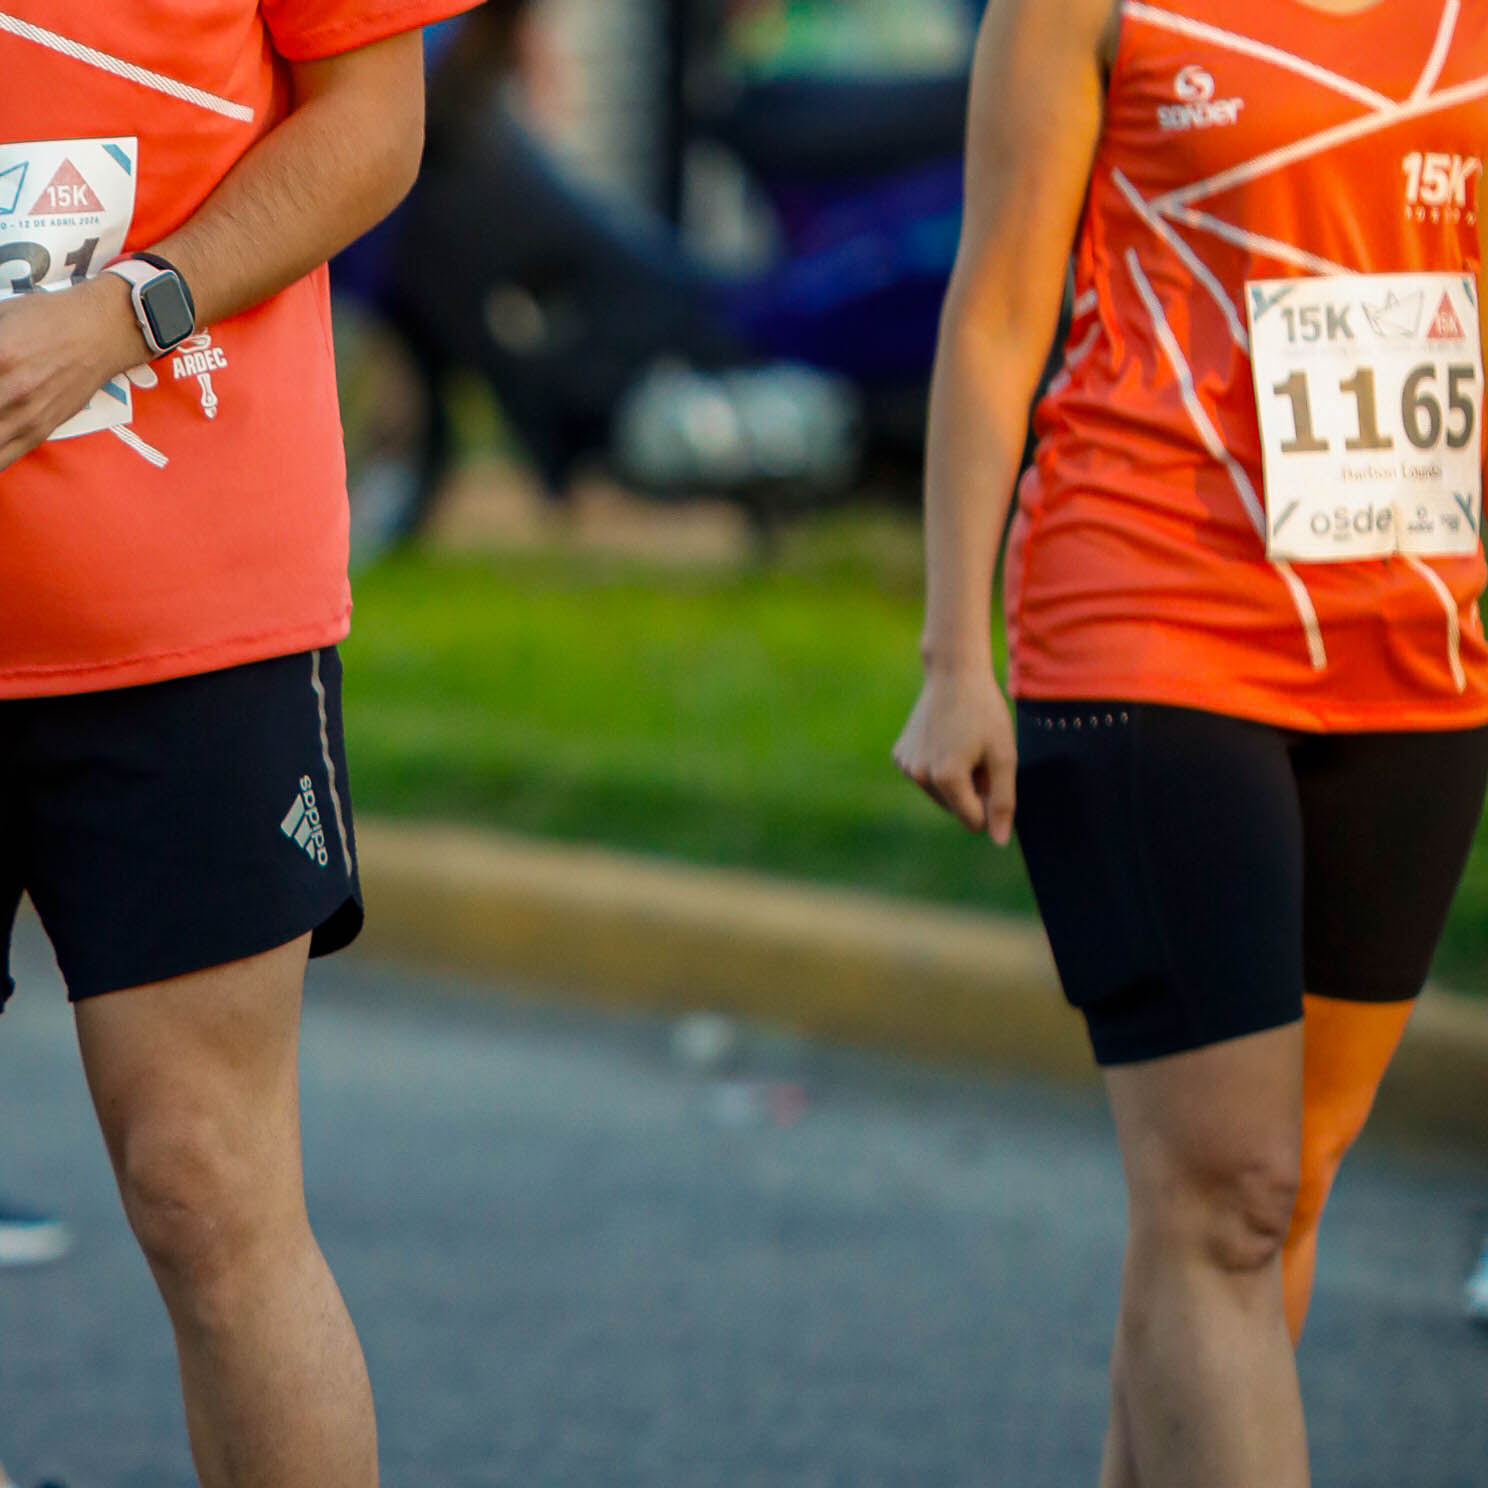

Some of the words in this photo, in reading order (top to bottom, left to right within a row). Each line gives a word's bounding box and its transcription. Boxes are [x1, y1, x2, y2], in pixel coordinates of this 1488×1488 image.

[46, 184, 89, 209] 15K
[33, 218, 46, 228] DE
[1280, 303, 1355, 343] 15K
[172, 346, 228, 380] ARDEC
[1273, 363, 1476, 454] 1165
[299, 774, 328, 866] adidas
